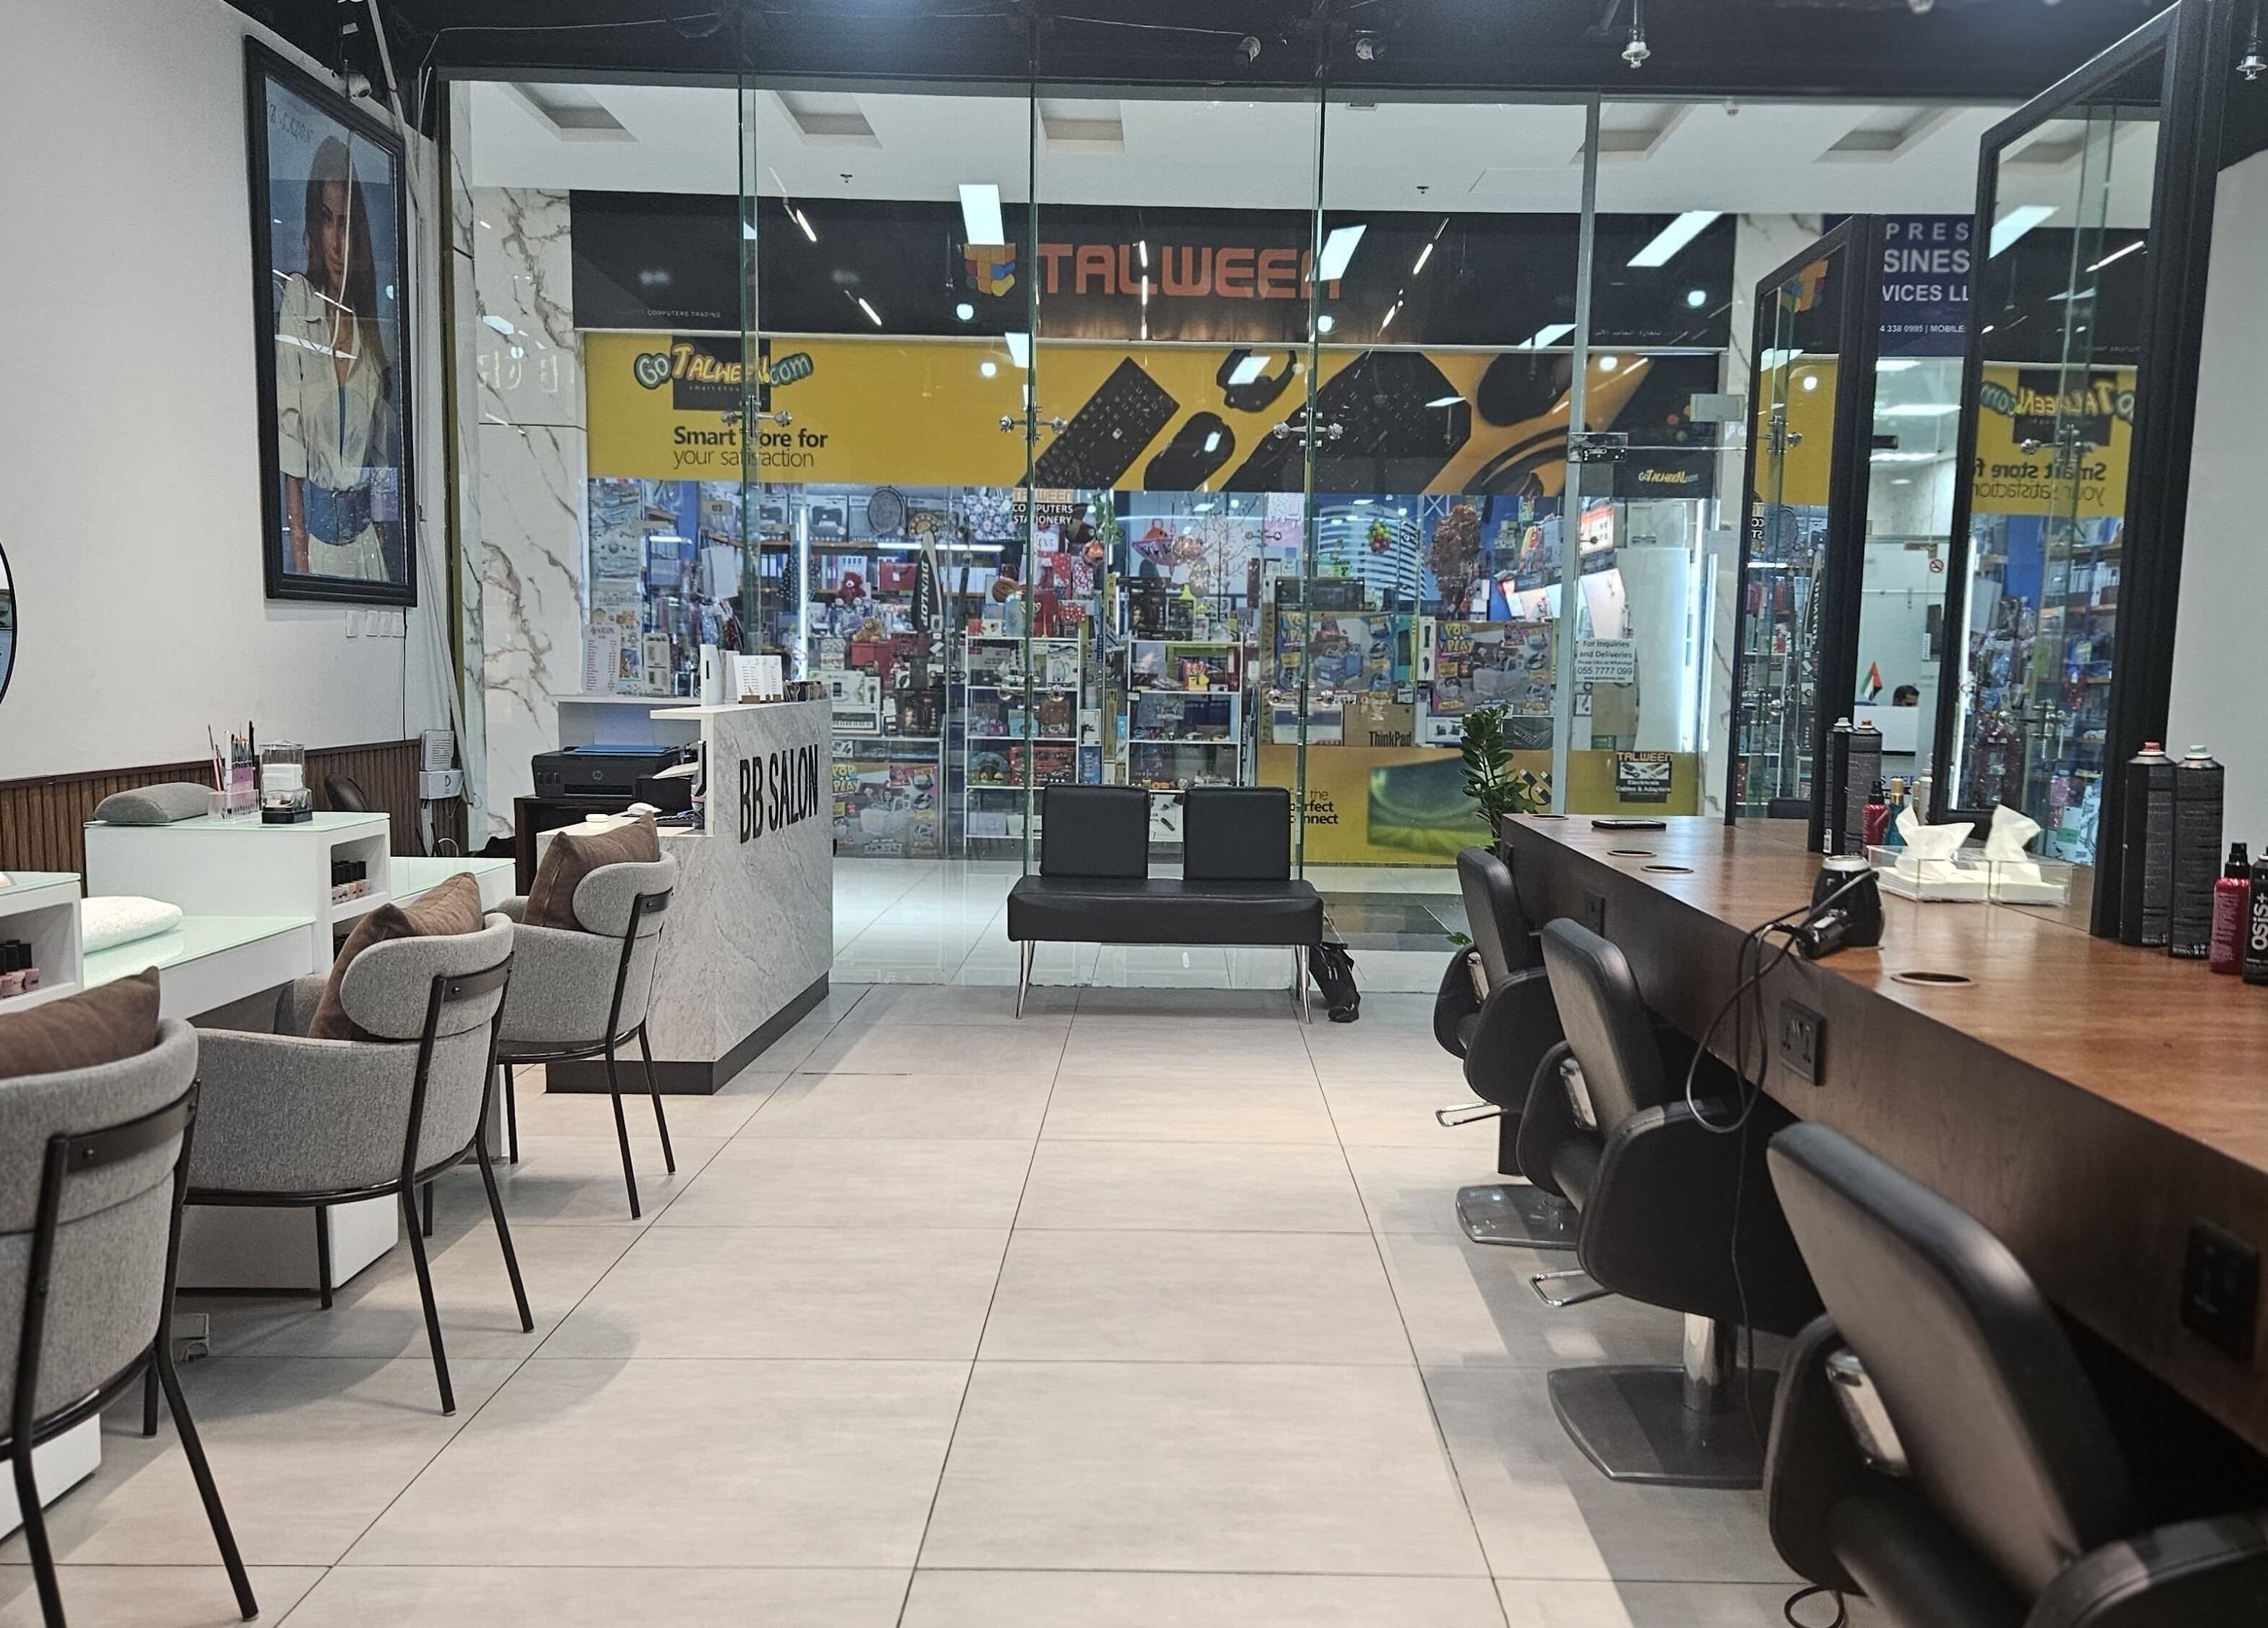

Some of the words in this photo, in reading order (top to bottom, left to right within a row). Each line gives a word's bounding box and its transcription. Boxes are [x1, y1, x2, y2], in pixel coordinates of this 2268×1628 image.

[674, 425, 736, 446] Smart
[742, 428, 792, 448] ore
[798, 428, 828, 448] for
[673, 449, 715, 470] your
[1013, 503, 1073, 514] COPUTERS
[1014, 514, 1071, 525] STIONERY
[920, 559, 930, 627] DUNLOP
[1369, 731, 1411, 747] ThinkPad
[740, 756, 763, 844] BB
[769, 745, 818, 831] SALON
[1310, 788, 1328, 801] the
[1290, 800, 1334, 814] rfect
[1290, 814, 1338, 824] nnect
